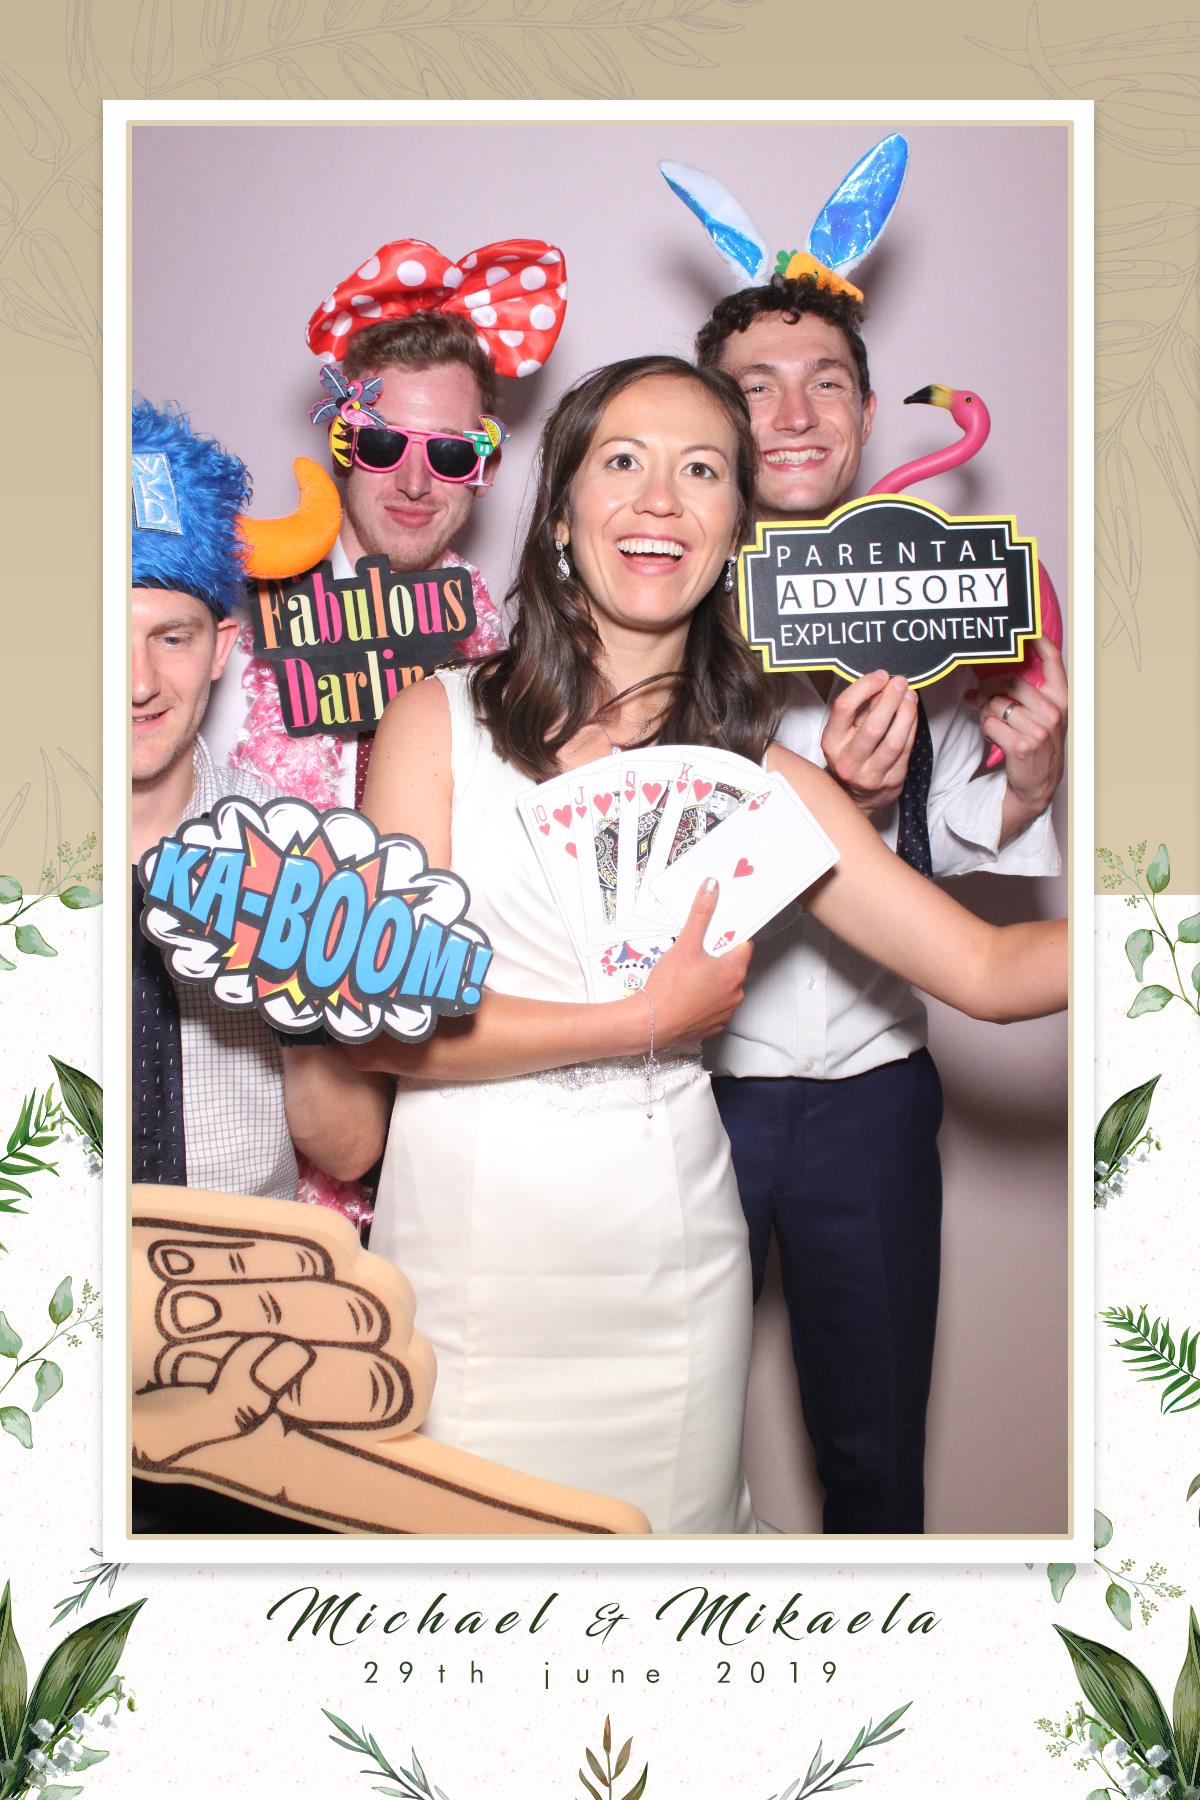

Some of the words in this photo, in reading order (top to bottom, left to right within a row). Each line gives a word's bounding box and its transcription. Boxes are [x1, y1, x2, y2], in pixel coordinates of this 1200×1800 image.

[776, 539, 1005, 568] PARENTAL
[780, 573, 1006, 609] ADVISORY
[257, 567, 467, 650] Fabulous
[780, 620, 887, 647] EXPLICIT
[892, 616, 1009, 642] CONTENT
[624, 770, 636, 788] Q
[677, 762, 694, 783] K
[574, 786, 585, 805] J
[759, 789, 773, 806] A
[531, 804, 548, 824] 10
[150, 841, 493, 1005] KA-BOOM!
